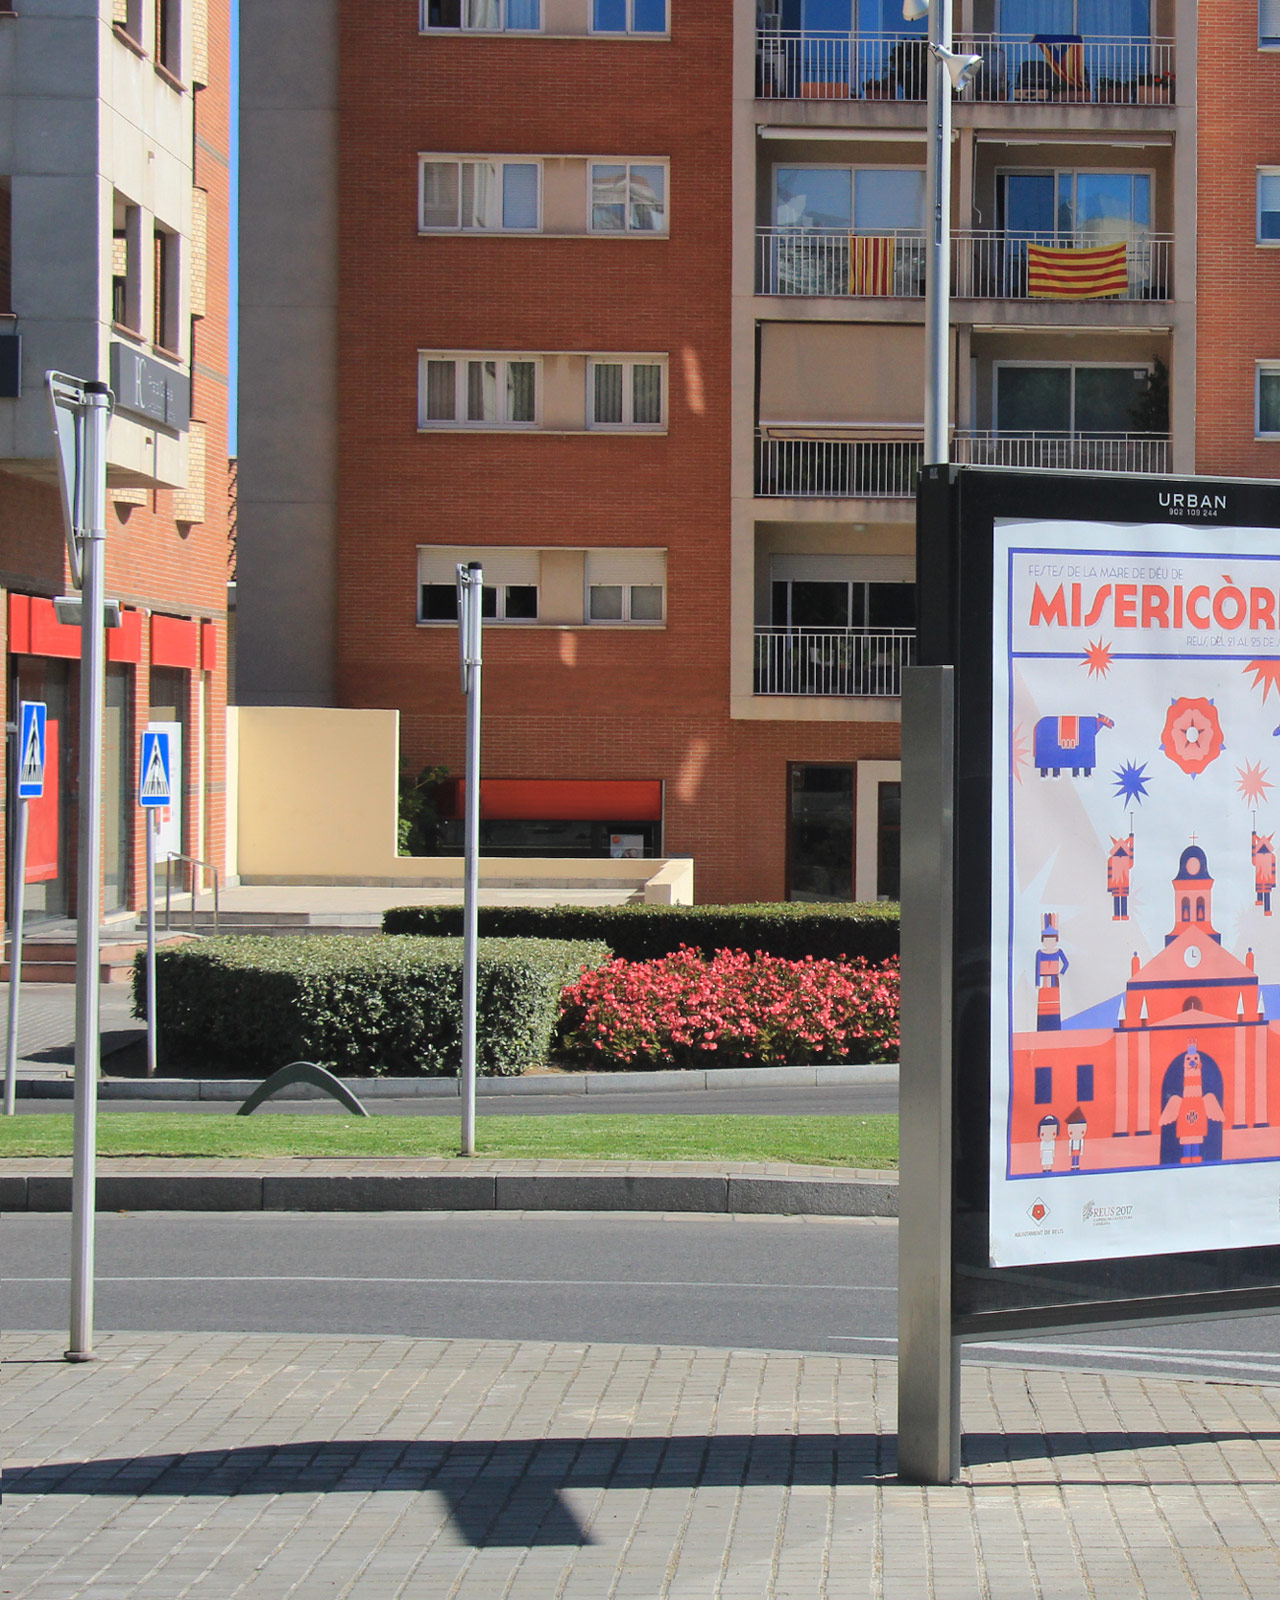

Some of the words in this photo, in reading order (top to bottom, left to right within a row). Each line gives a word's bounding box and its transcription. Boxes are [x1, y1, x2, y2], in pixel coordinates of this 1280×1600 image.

[1158, 492, 1227, 509] URBAN
[1168, 507, 1184, 516] 902
[1187, 508, 1201, 517] 109
[1202, 509, 1218, 517] 244
[1028, 564, 1064, 577] FESTES
[1067, 565, 1080, 578] DE
[1083, 566, 1097, 578] LA
[1100, 567, 1130, 579] MARE
[1132, 567, 1146, 580] DE
[1148, 566, 1168, 580] DÉU
[1171, 568, 1184, 580] DE
[1237, 636, 1249, 648] AL
[1263, 637, 1274, 648] DE
[1115, 1205, 1134, 1216] 2017
